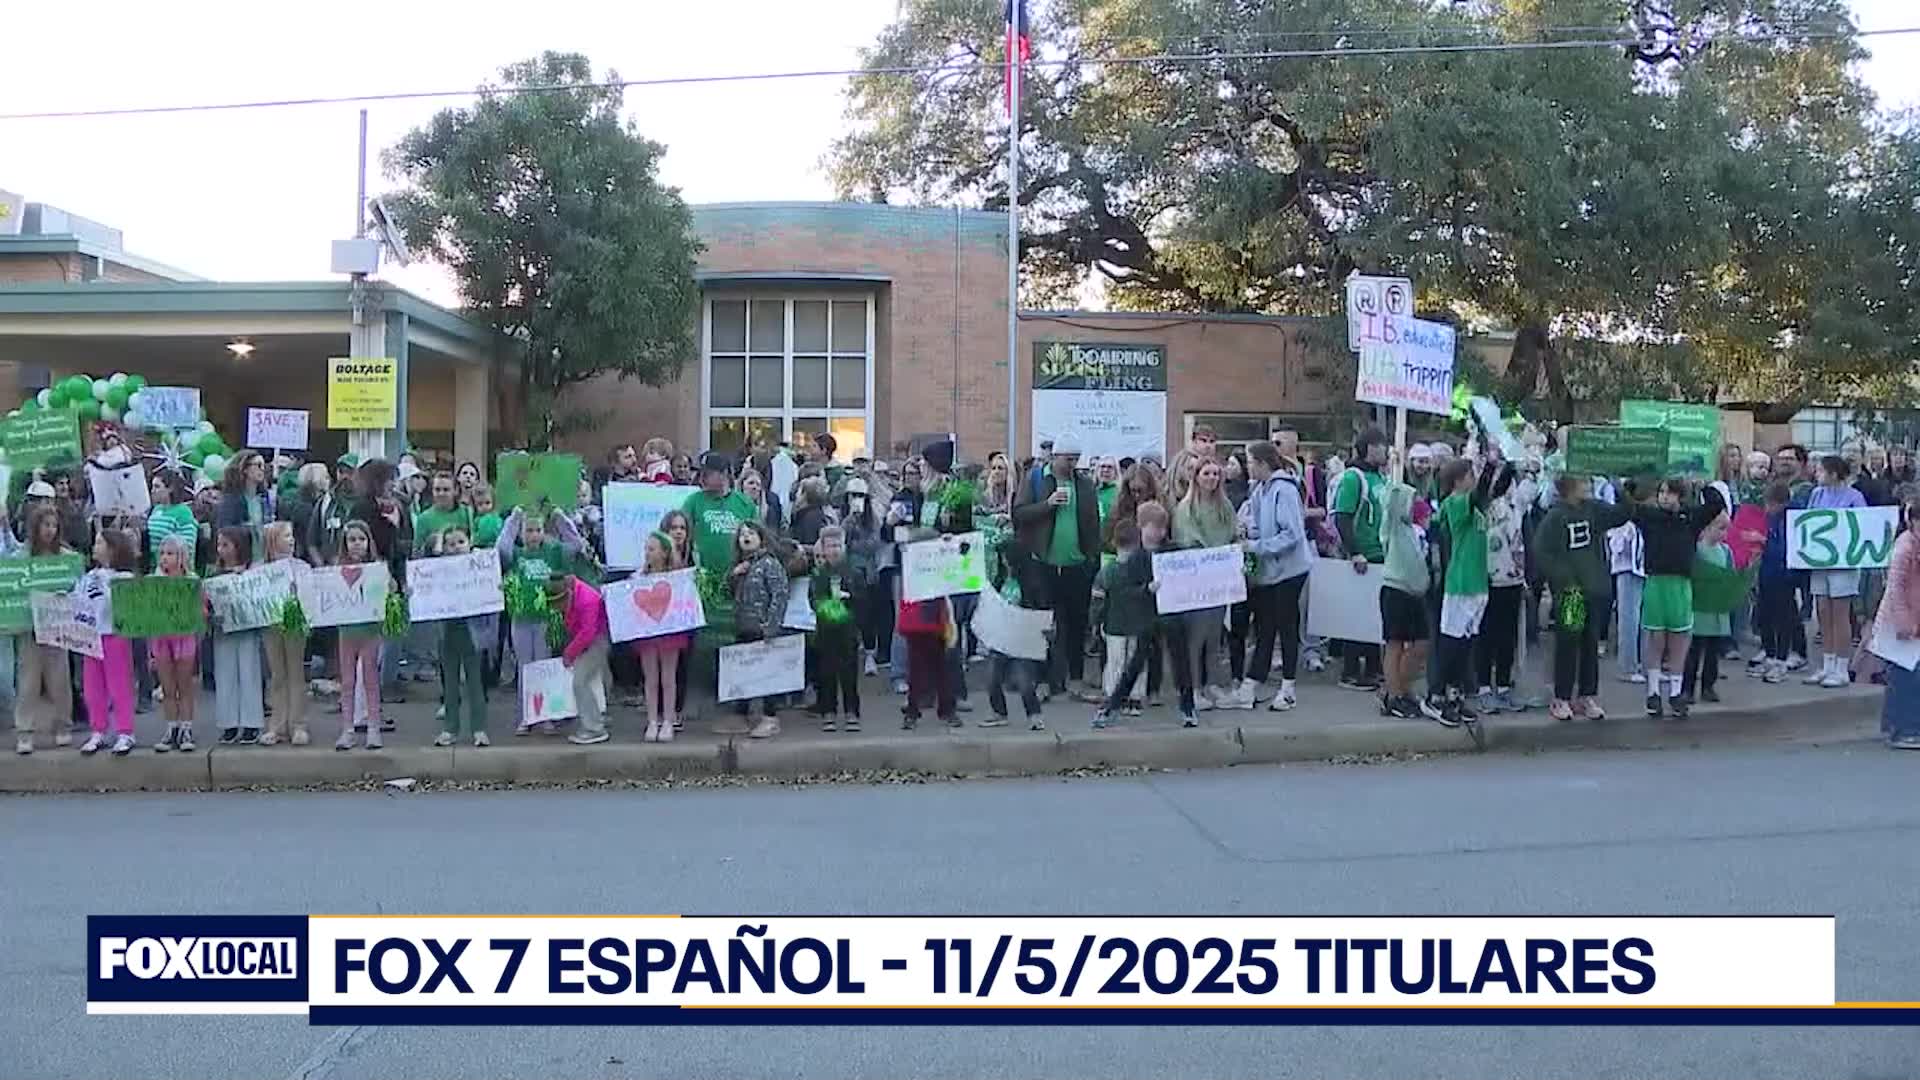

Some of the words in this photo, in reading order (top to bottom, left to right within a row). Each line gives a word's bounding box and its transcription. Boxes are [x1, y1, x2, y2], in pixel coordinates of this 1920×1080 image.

[1071, 349, 1159, 366] ROARING
[336, 364, 392, 376] BOLTAGE
[1085, 375, 1153, 390] FLING
[255, 412, 290, 426] SAVE
[1567, 520, 1591, 548] B
[1794, 509, 1892, 568] BW
